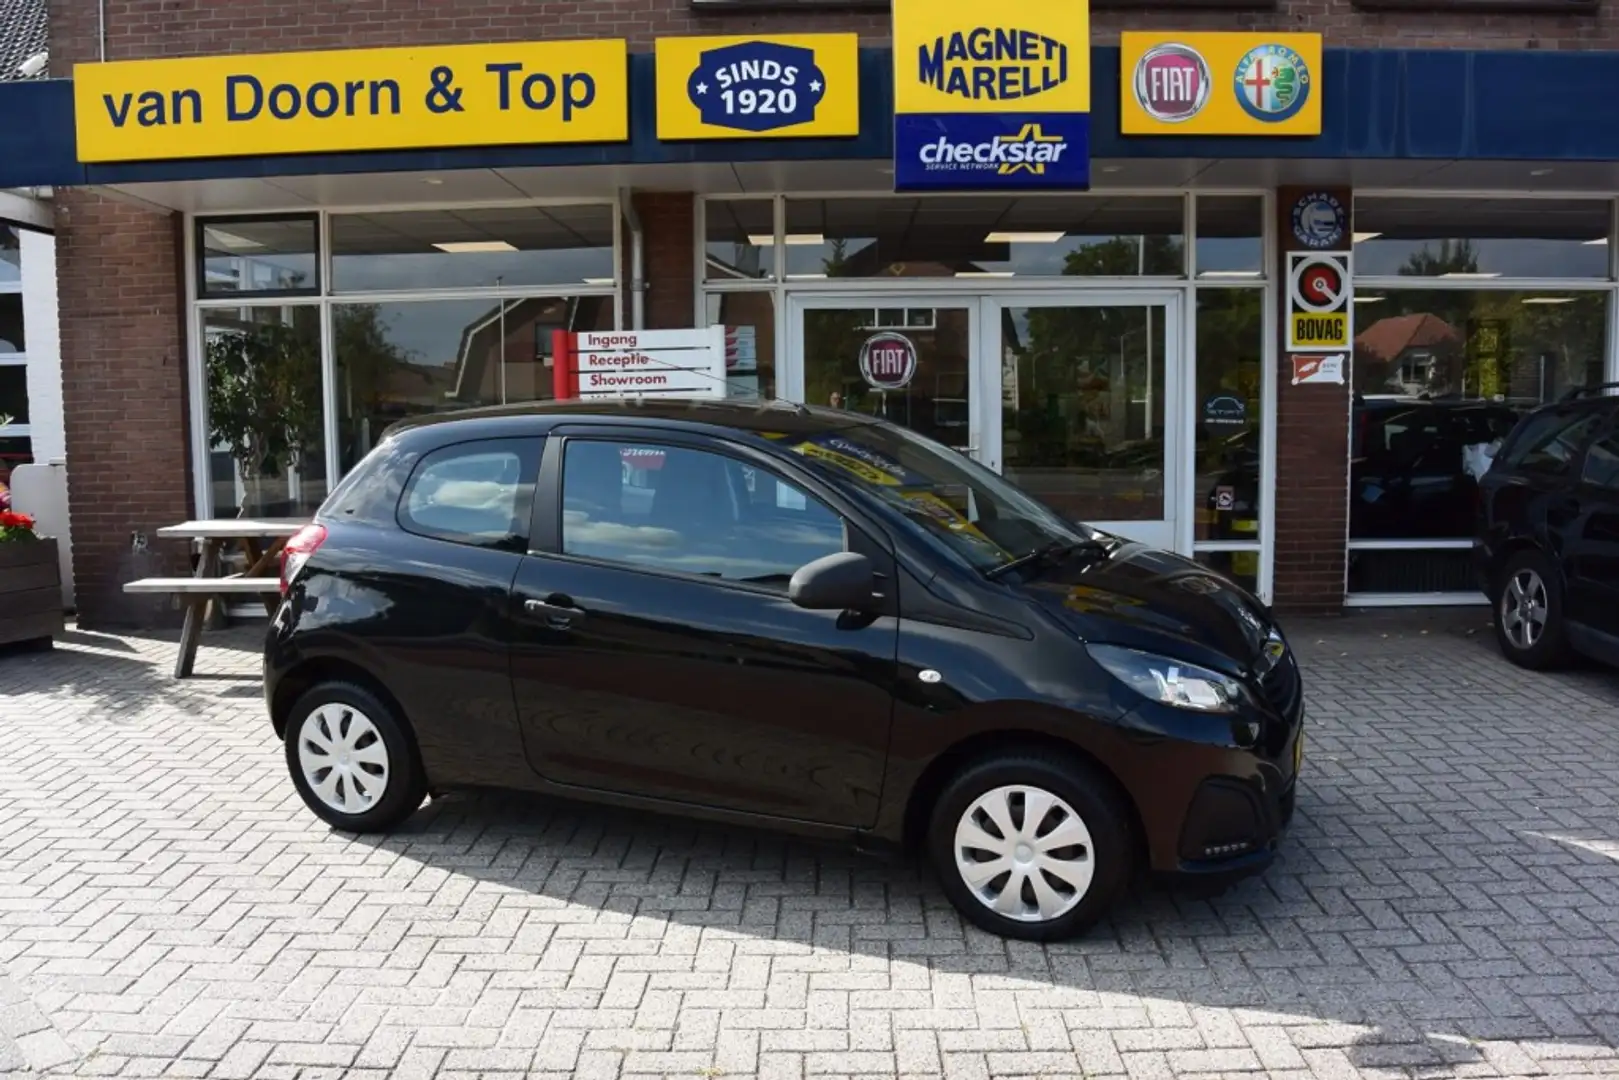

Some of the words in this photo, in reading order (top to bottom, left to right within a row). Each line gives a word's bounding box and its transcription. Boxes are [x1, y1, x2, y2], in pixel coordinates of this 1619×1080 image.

[918, 27, 1067, 75] MAGNETI
[714, 59, 799, 89] SINDS
[918, 52, 1067, 101] MARELLI
[1151, 67, 1195, 101] FIAT
[102, 88, 202, 128] van
[225, 74, 400, 121] Doorn
[424, 65, 465, 113] &
[485, 62, 597, 121] Top
[720, 88, 797, 115] 1920
[919, 136, 1067, 163] checkstar
[925, 162, 957, 171] SERVICE
[960, 162, 999, 170] NETWORK
[588, 333, 638, 348] Ingang
[1296, 318, 1343, 341] BOVAG
[588, 353, 650, 367] Receptie
[872, 349, 905, 374] FIAT
[590, 374, 667, 386] Showroom
